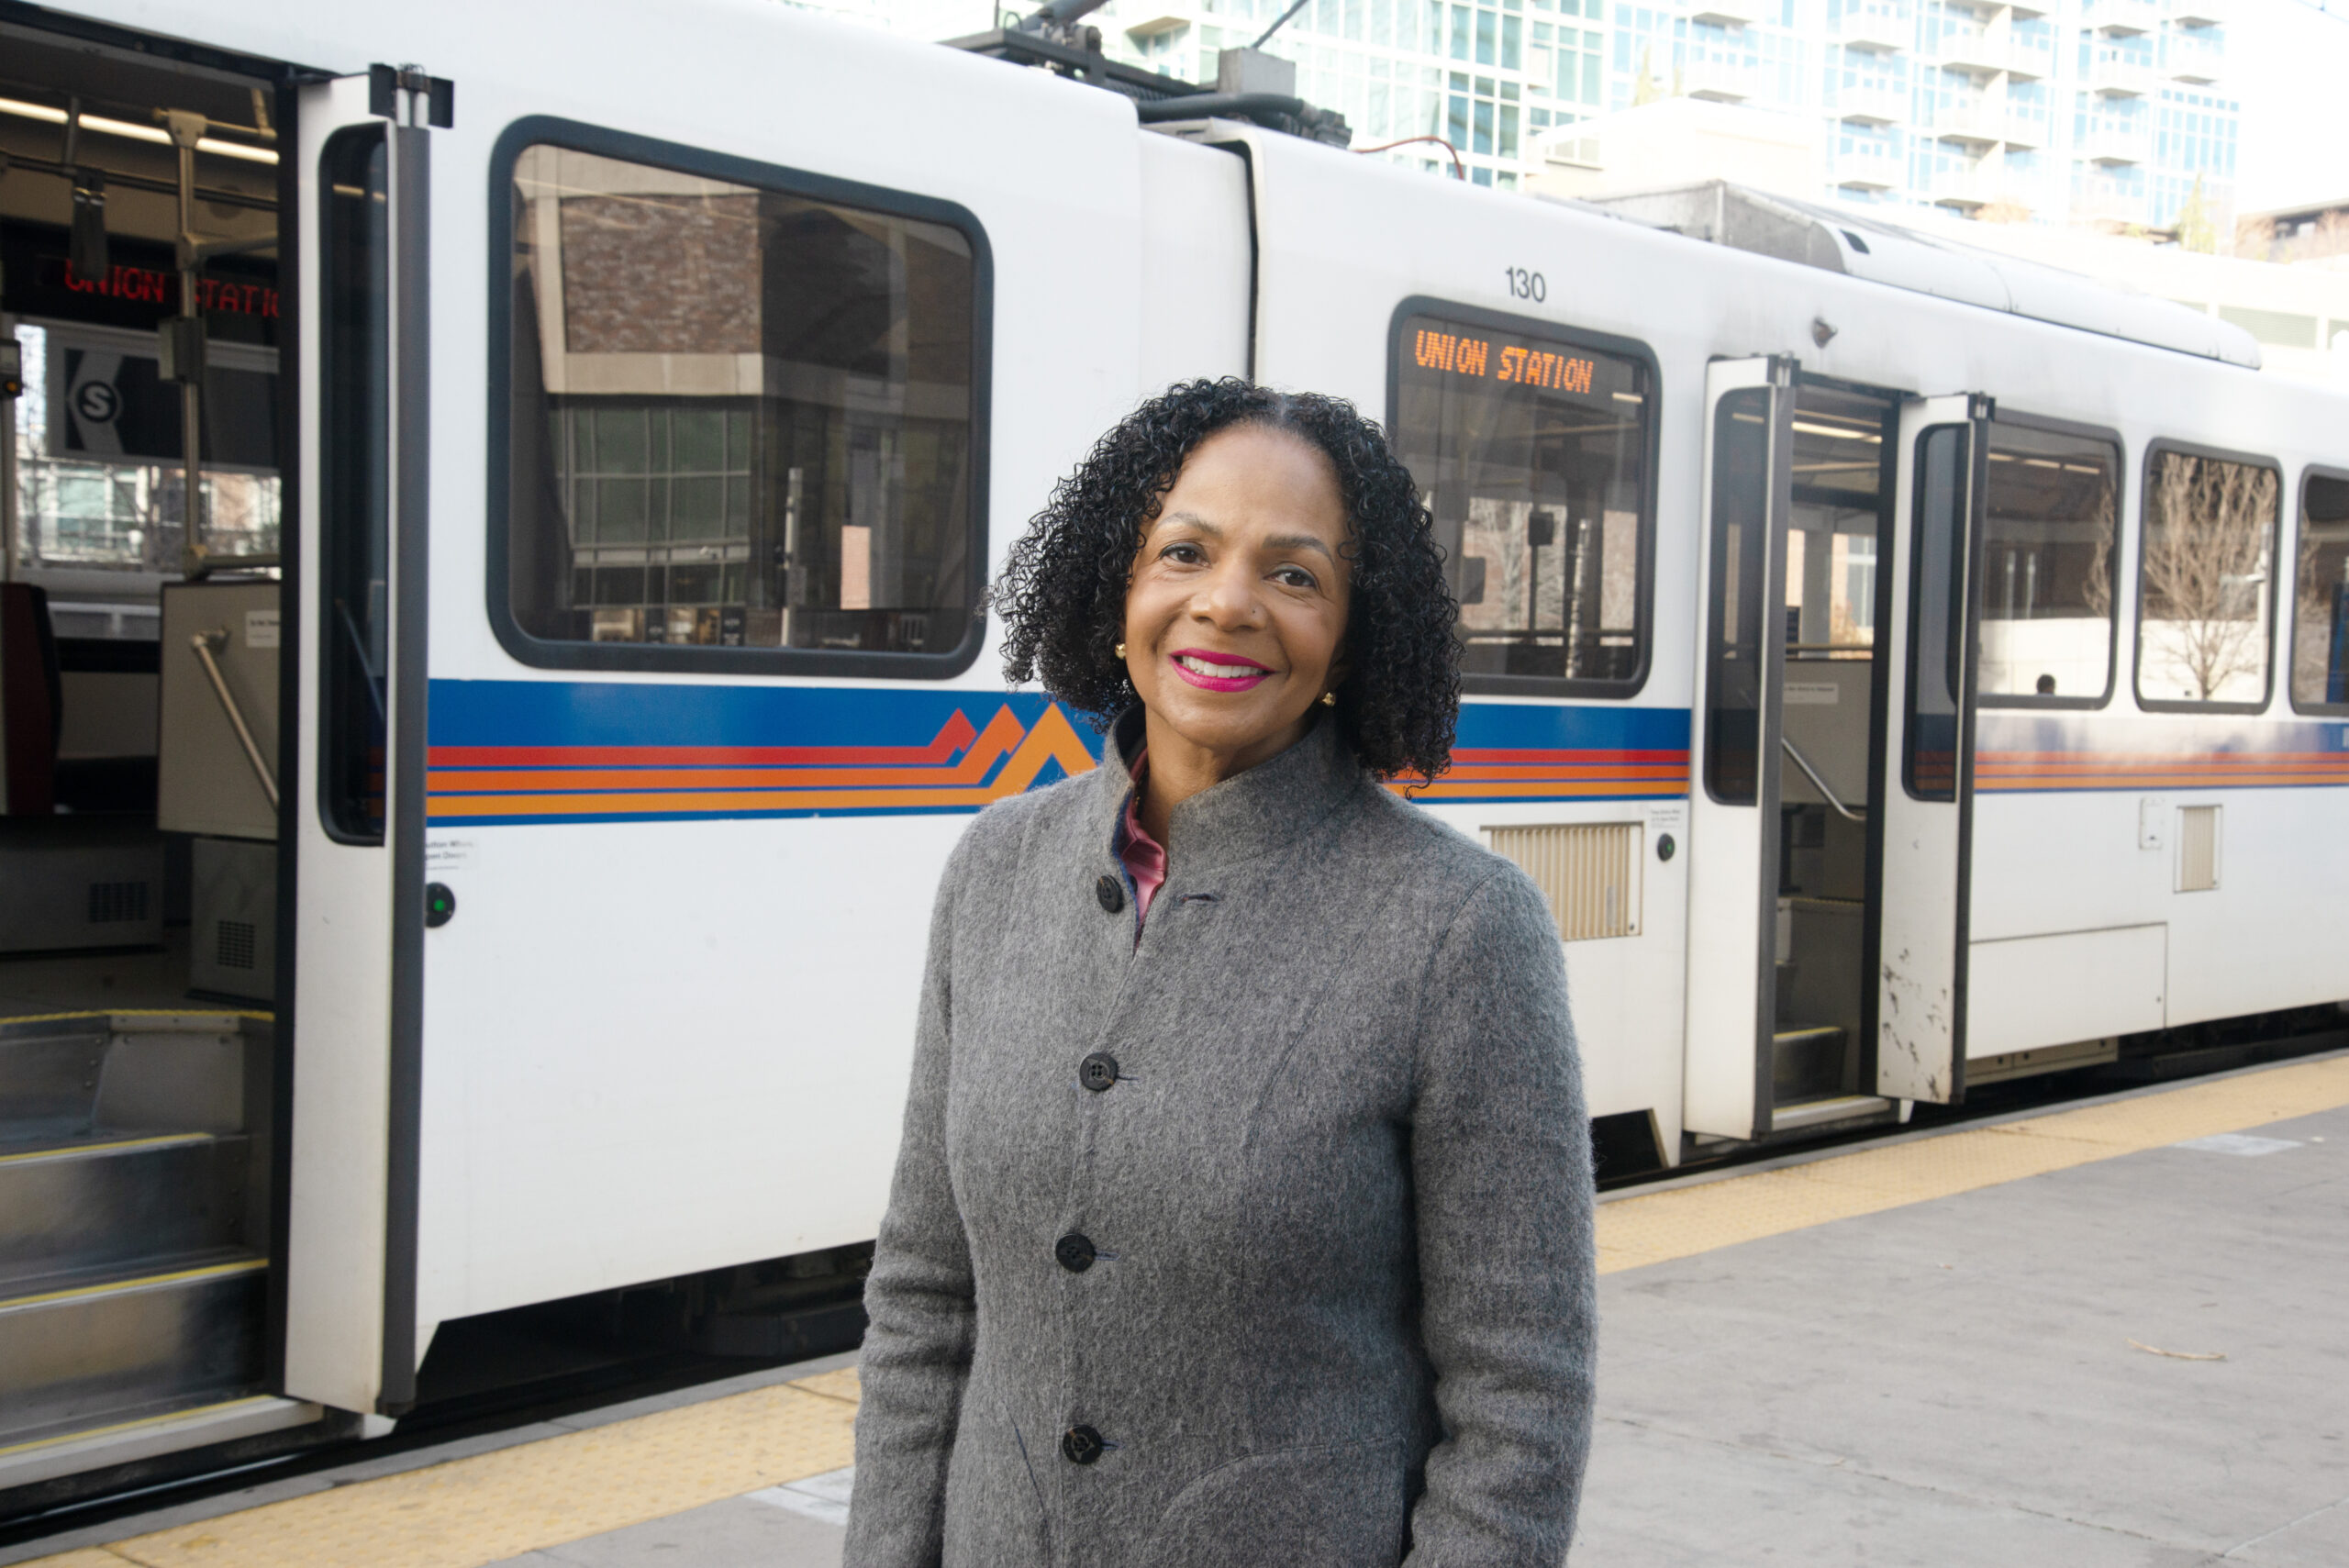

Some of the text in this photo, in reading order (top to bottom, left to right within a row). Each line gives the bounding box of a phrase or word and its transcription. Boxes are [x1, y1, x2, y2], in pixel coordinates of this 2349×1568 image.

[1506, 266, 1547, 304] 130
[1414, 329, 1594, 395] UNION STATION
[83, 383, 110, 417] S
